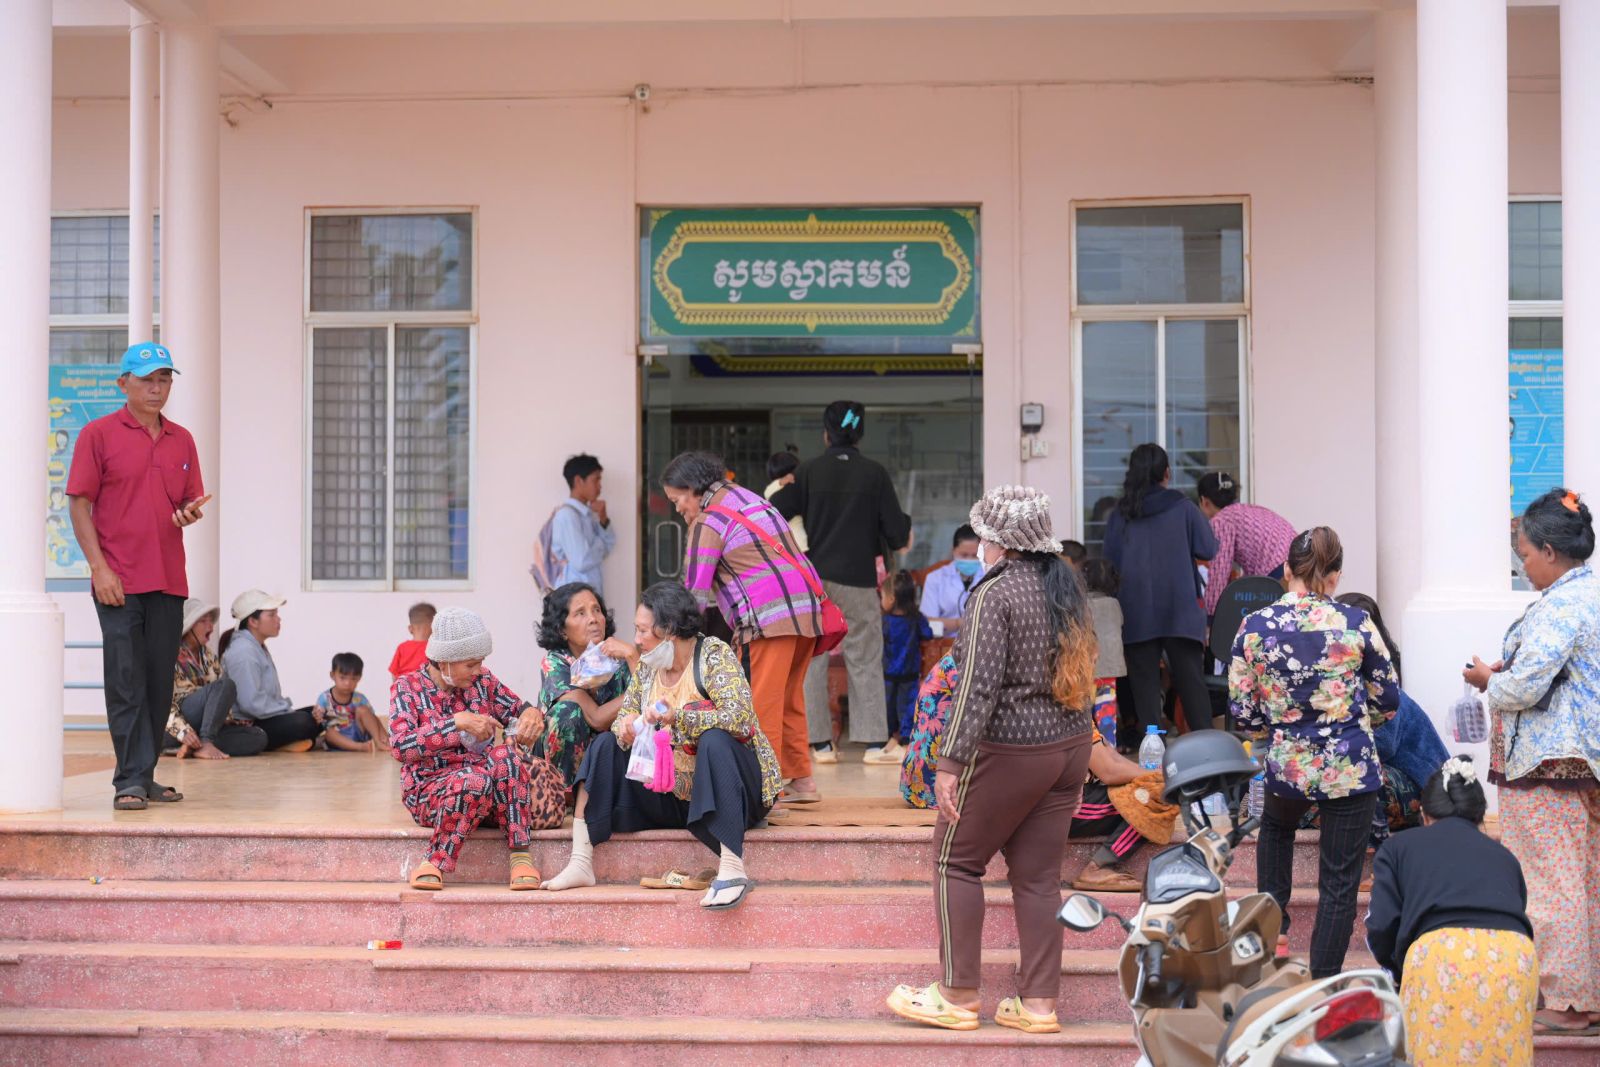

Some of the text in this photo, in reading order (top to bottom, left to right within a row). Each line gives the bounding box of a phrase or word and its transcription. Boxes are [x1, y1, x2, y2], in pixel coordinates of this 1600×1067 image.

[713, 244, 912, 303] សូមស្វាគមន៍
